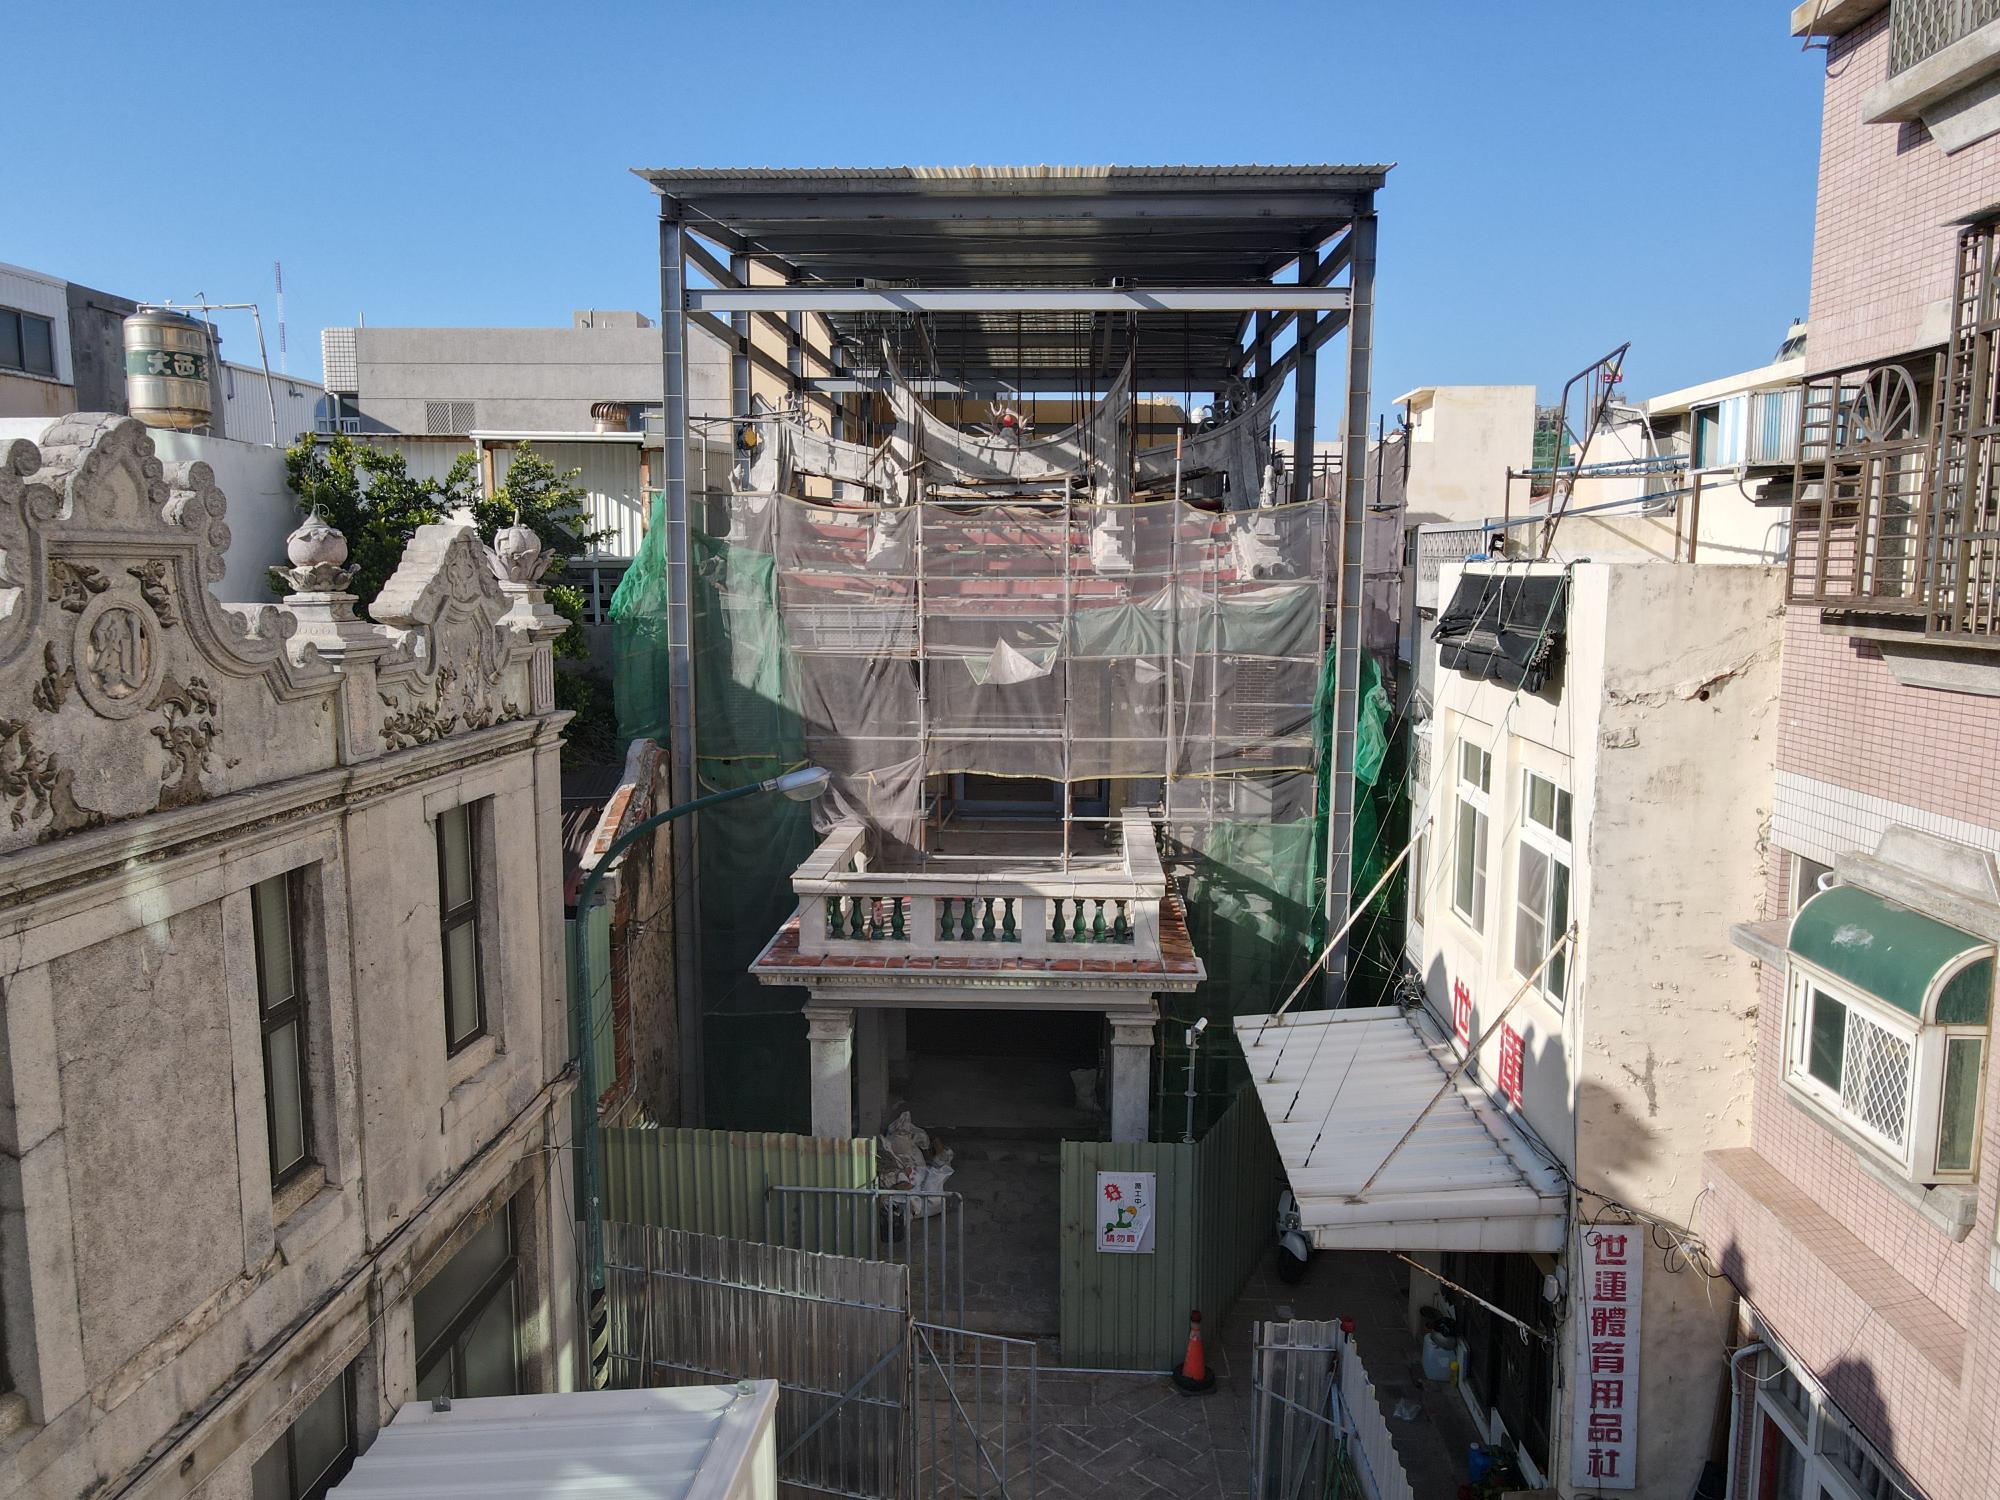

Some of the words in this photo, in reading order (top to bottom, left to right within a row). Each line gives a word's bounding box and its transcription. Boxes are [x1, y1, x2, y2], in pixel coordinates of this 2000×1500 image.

[1586, 1234, 1628, 1478] 世運體育用品社
